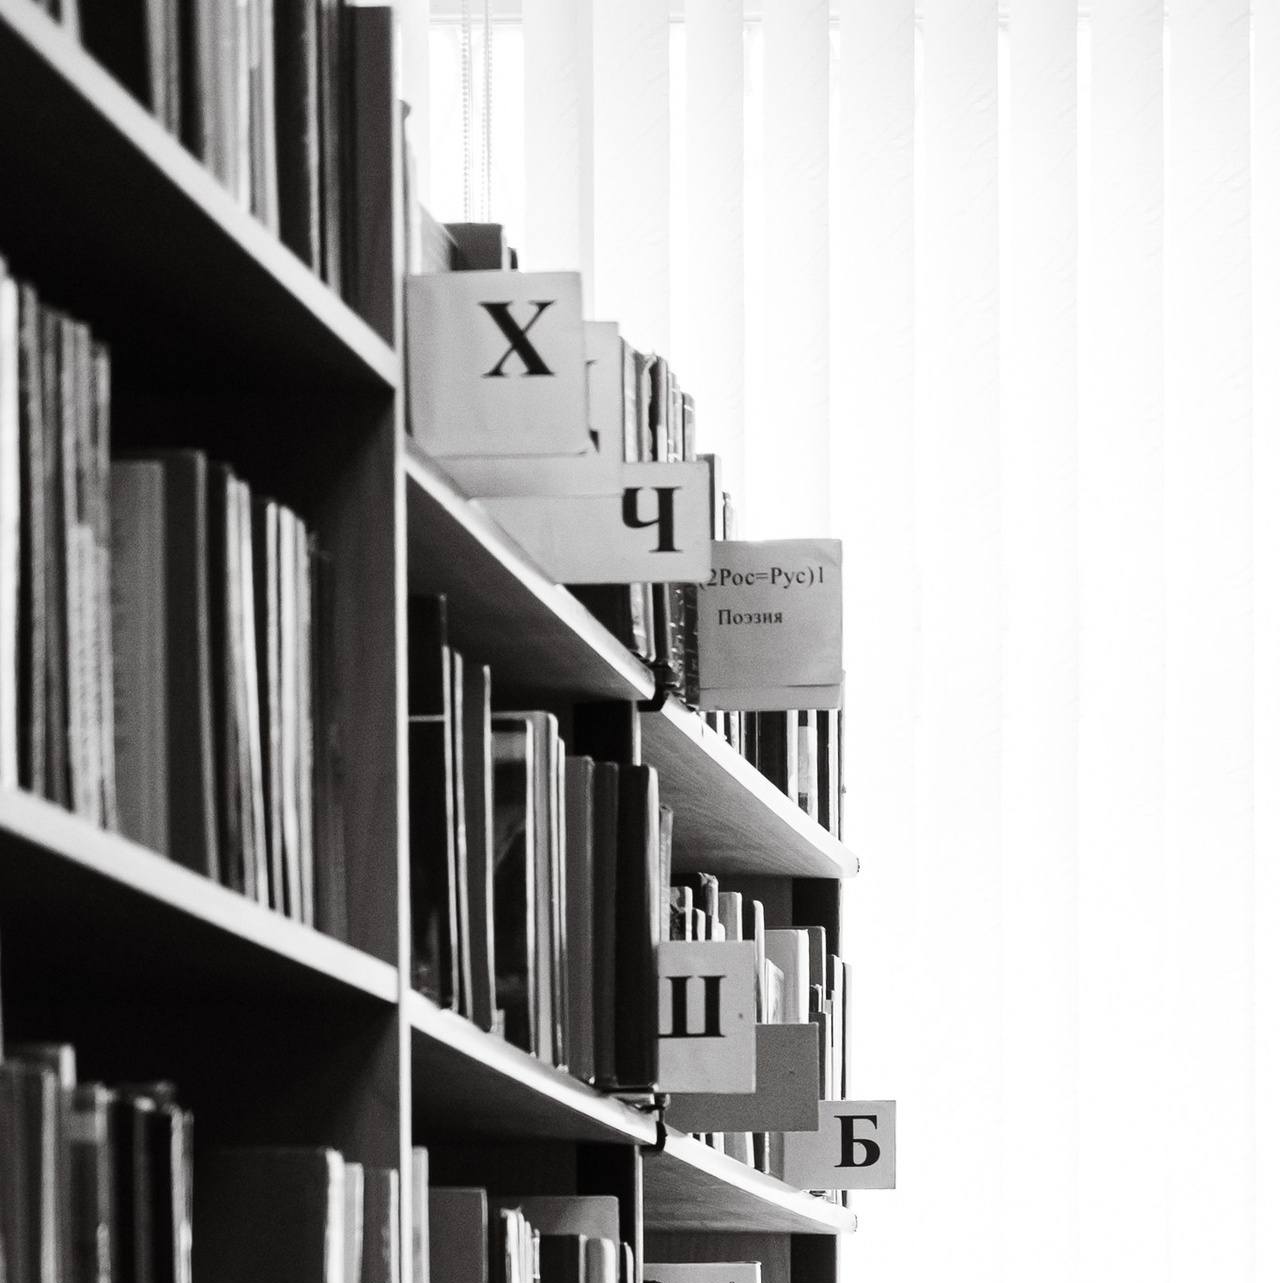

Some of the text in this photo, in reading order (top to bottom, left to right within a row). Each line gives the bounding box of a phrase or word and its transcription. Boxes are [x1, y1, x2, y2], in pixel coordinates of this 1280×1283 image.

[478, 300, 556, 378] Х
[621, 486, 683, 553] Ч
[718, 608, 783, 626] Поэзия
[834, 1114, 881, 1168] Б
